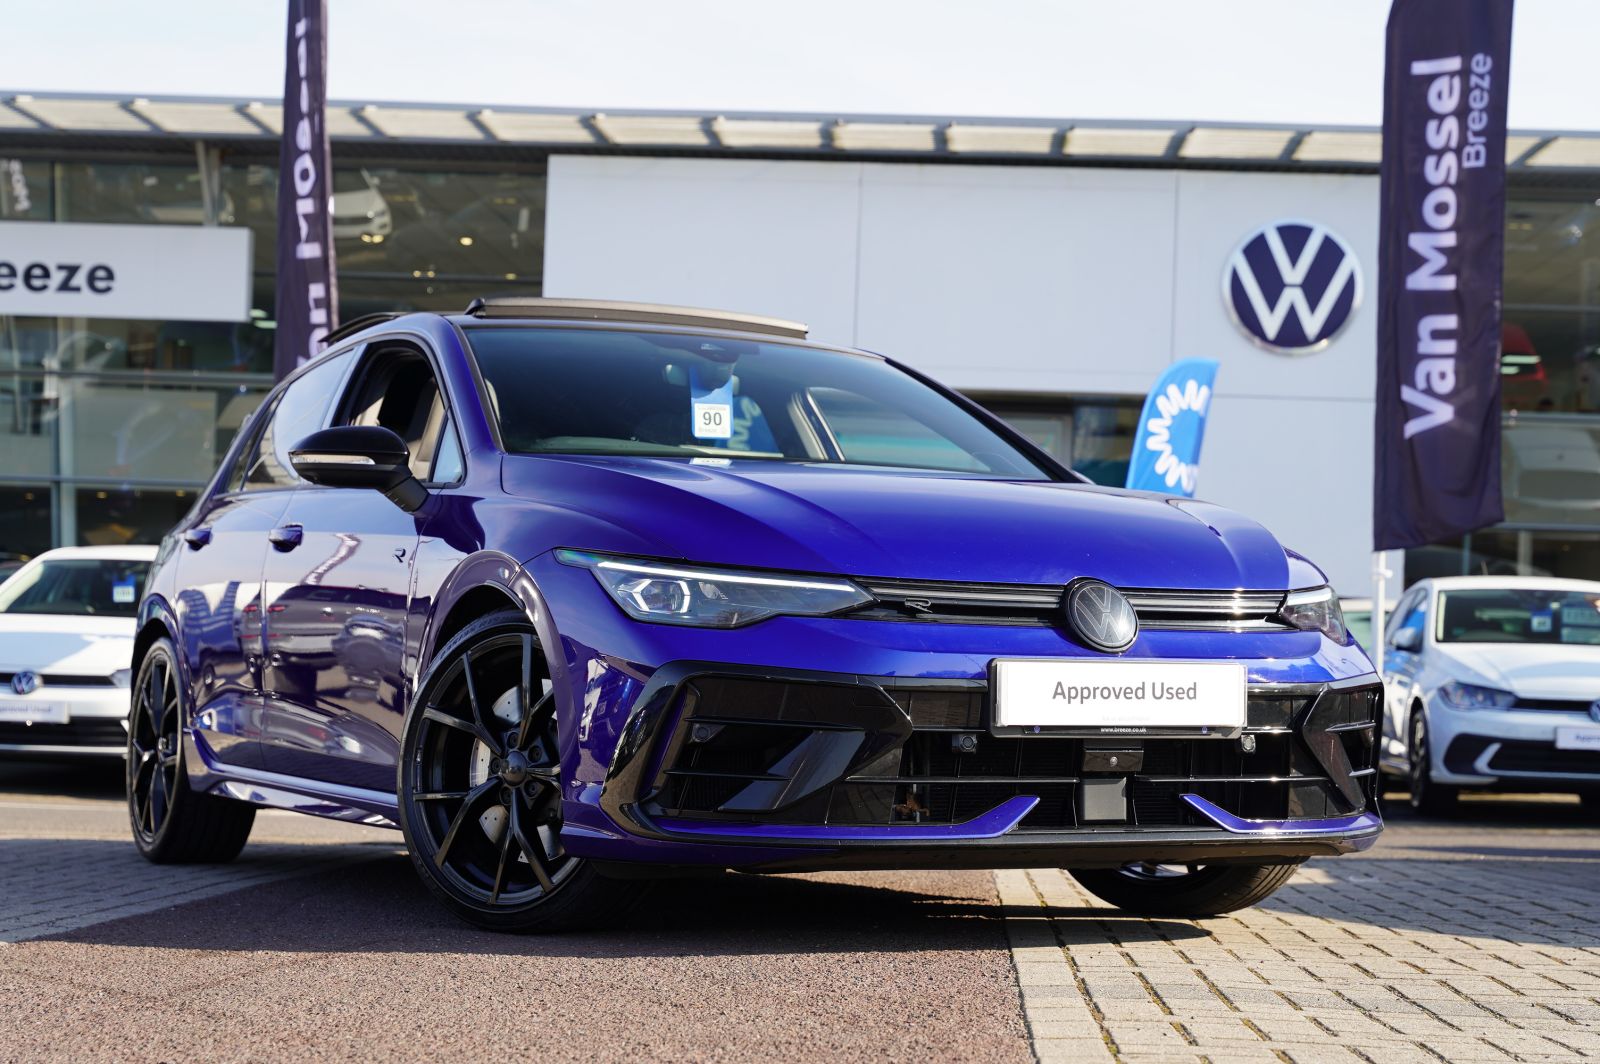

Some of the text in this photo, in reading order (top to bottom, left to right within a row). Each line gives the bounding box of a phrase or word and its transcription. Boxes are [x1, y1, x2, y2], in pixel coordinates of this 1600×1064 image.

[1461, 52, 1493, 169] Breeze
[1400, 55, 1462, 440] Van Mossel
[0, 261, 115, 294] eeze
[703, 411, 722, 426] 90
[1052, 681, 1197, 704] Approved Used
